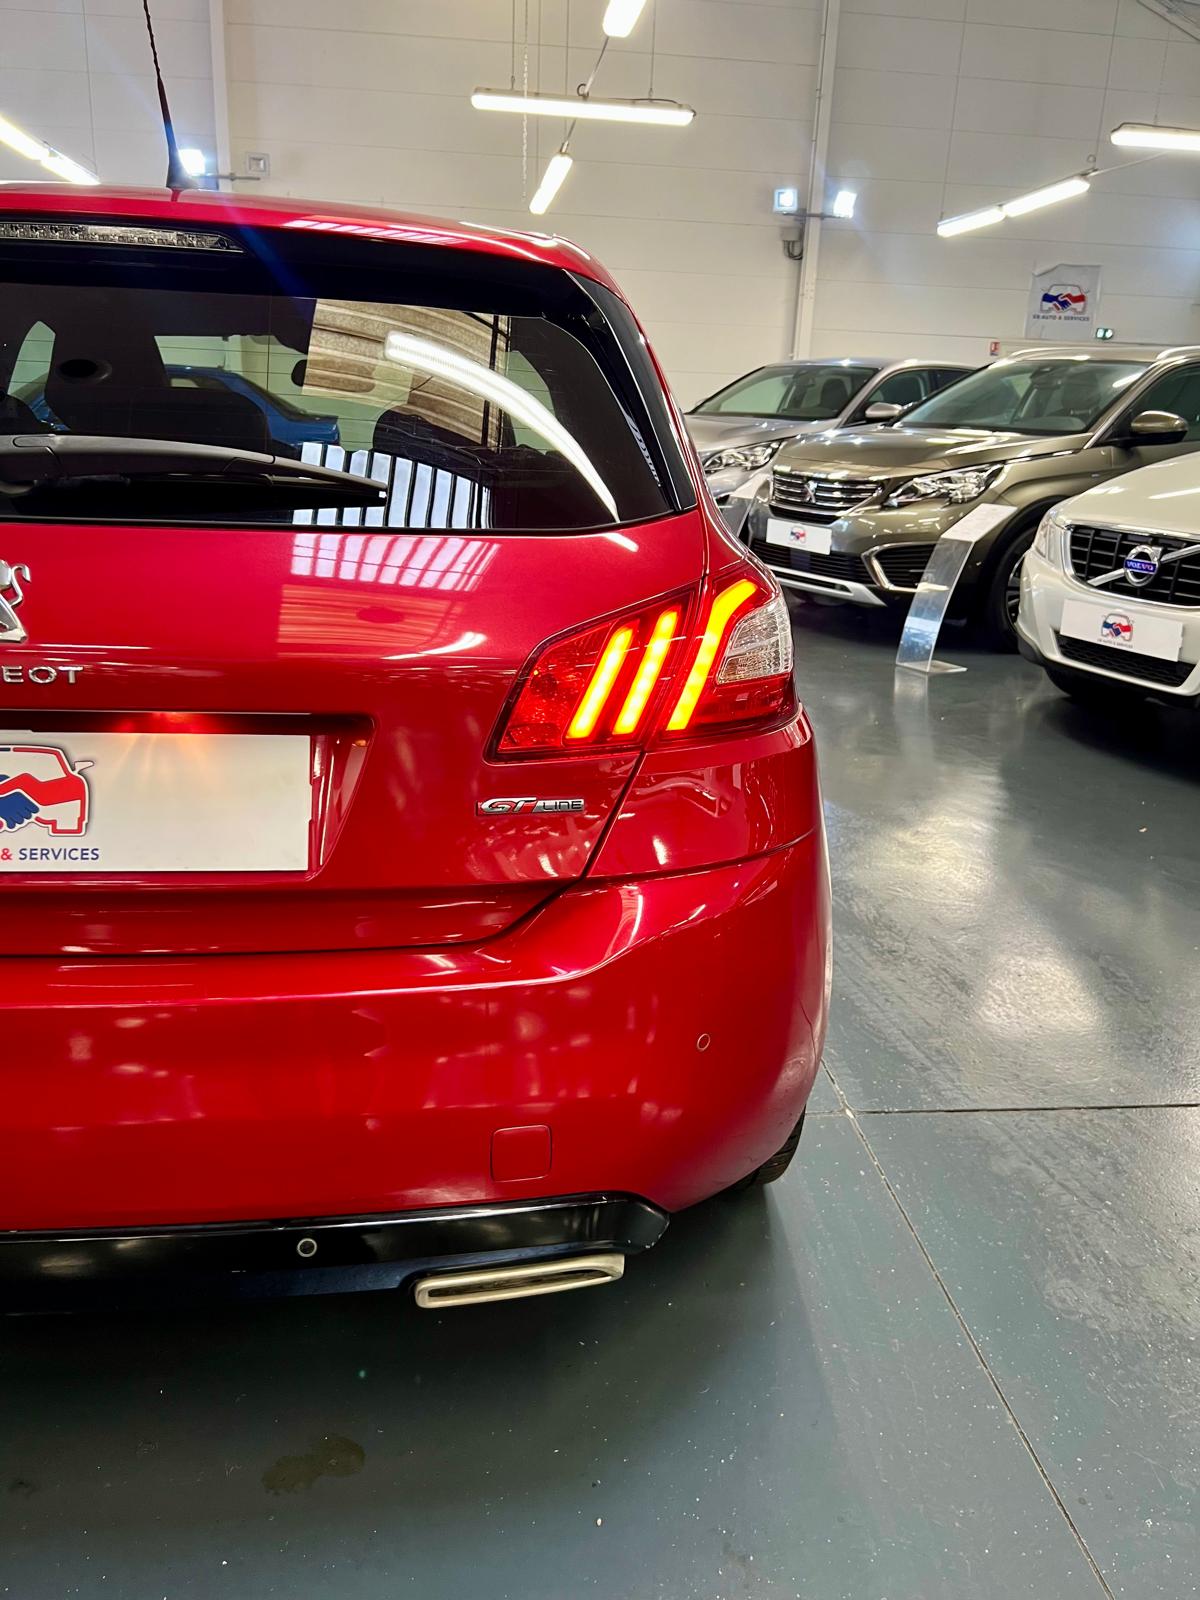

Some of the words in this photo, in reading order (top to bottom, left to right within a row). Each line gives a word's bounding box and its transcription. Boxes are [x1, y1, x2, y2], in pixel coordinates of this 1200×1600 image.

[1126, 560, 1154, 571] VOLVO
[481, 797, 537, 814] GT
[542, 800, 583, 811] LINE
[0, 847, 12, 861] &
[18, 847, 100, 861] SERVICES
